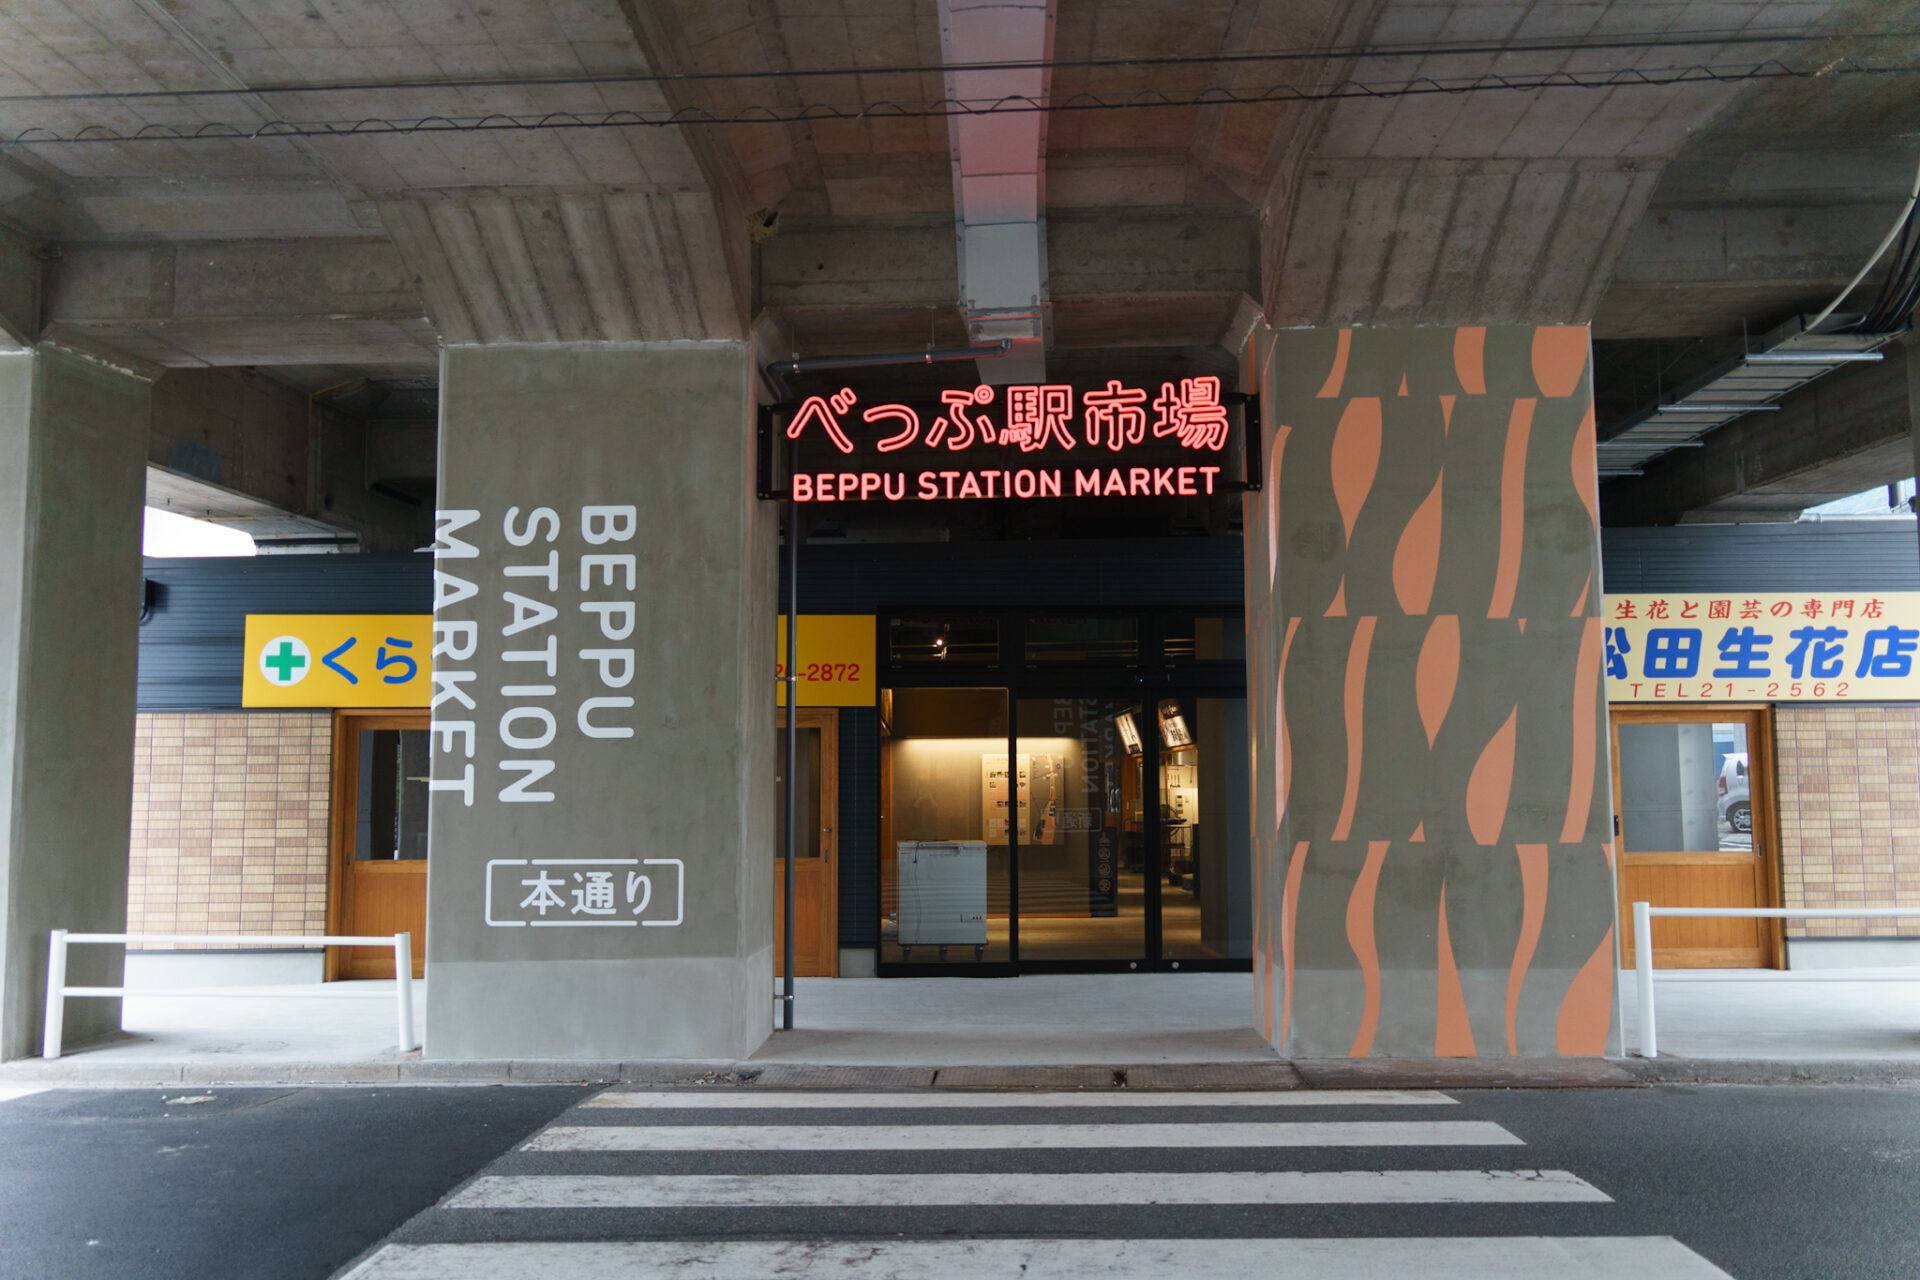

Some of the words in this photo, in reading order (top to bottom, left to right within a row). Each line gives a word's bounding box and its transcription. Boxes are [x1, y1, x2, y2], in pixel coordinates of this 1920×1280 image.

[787, 376, 1229, 453] べっぷ駅市場
[793, 472, 906, 502] BEPPU
[917, 469, 1062, 499] STATION
[1074, 466, 1220, 497] MARKET
[577, 505, 637, 738] BEPPU
[1615, 599, 1885, 619] 生花と園芸の専門店
[322, 636, 433, 684] くら
[429, 509, 480, 807] MARKET
[499, 507, 560, 802] STATION
[519, 871, 652, 915] 本通り
